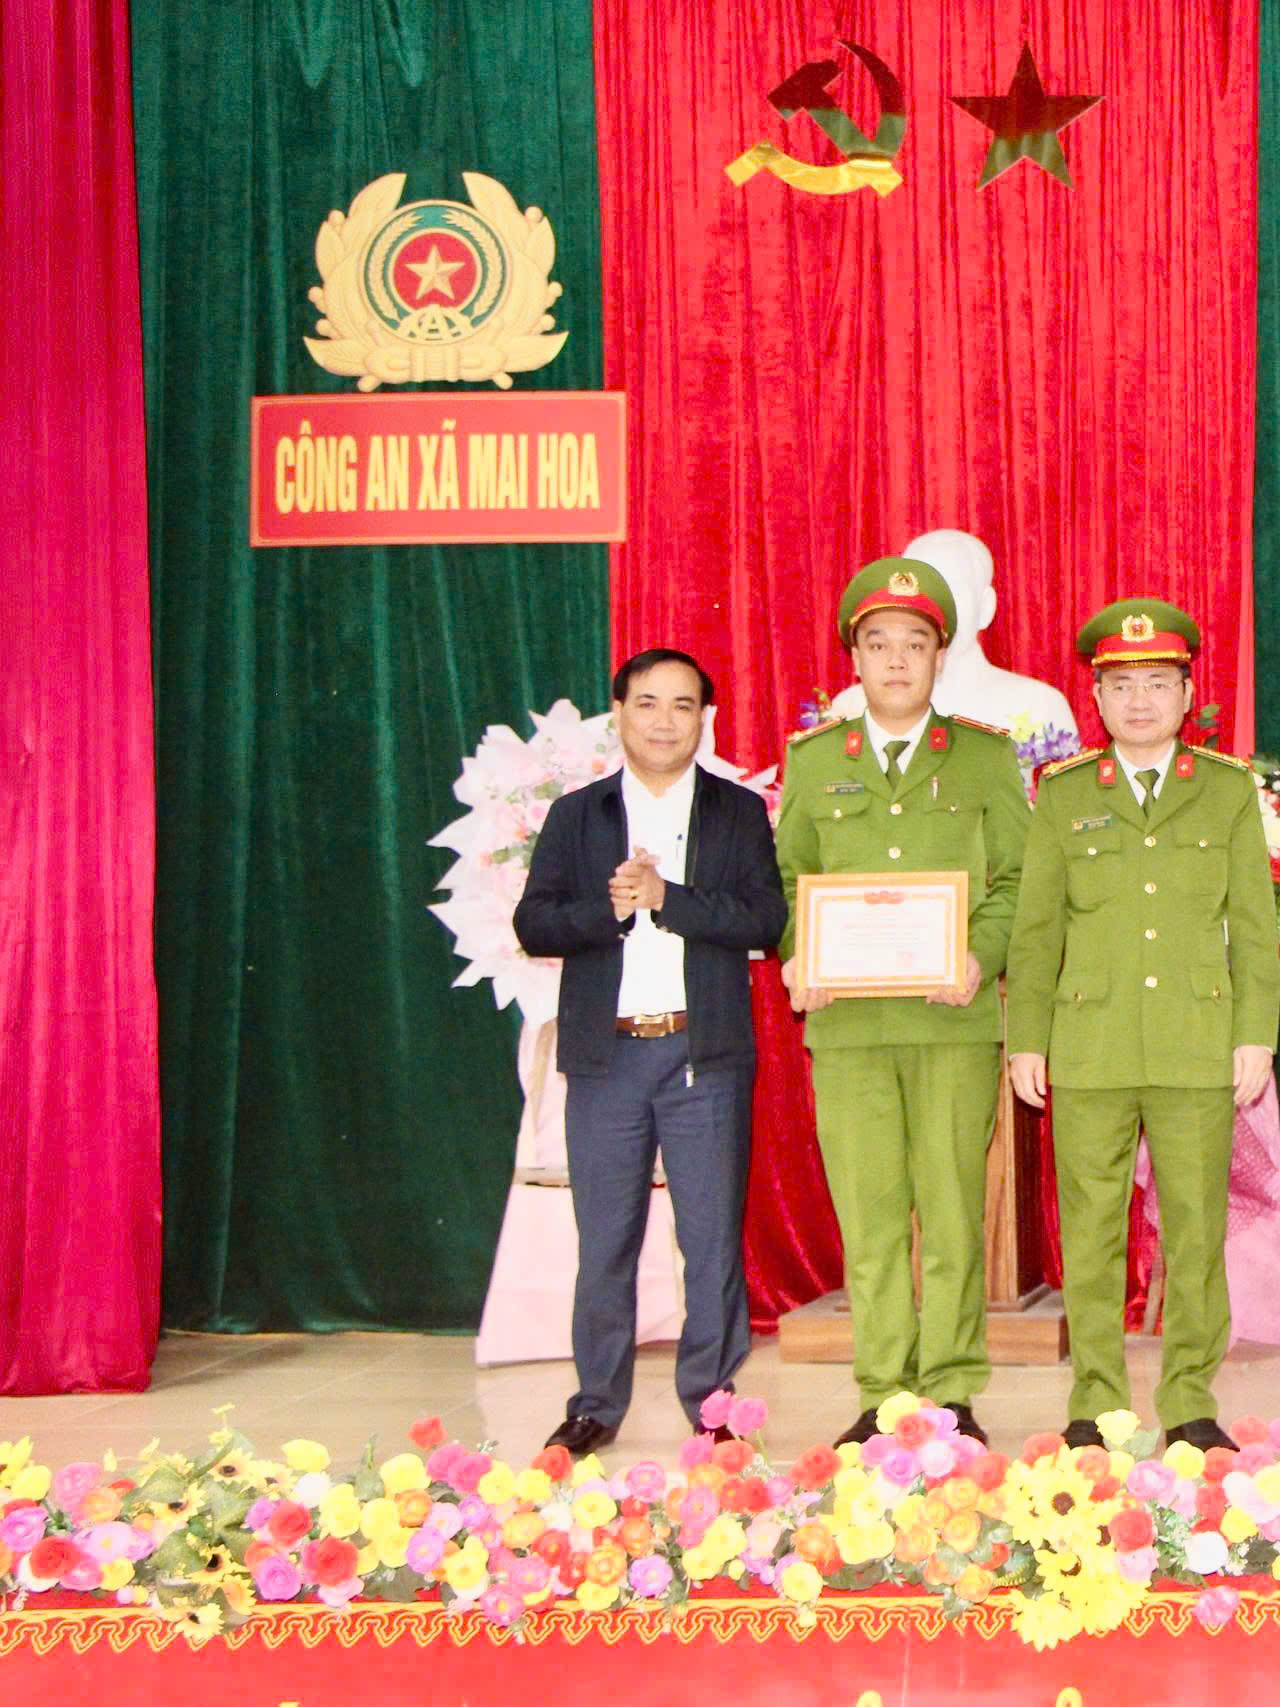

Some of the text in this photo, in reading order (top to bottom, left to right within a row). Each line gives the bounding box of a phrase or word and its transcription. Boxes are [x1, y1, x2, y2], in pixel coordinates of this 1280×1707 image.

[275, 419, 600, 514] CÔNG AN XÃ MAI HOA
